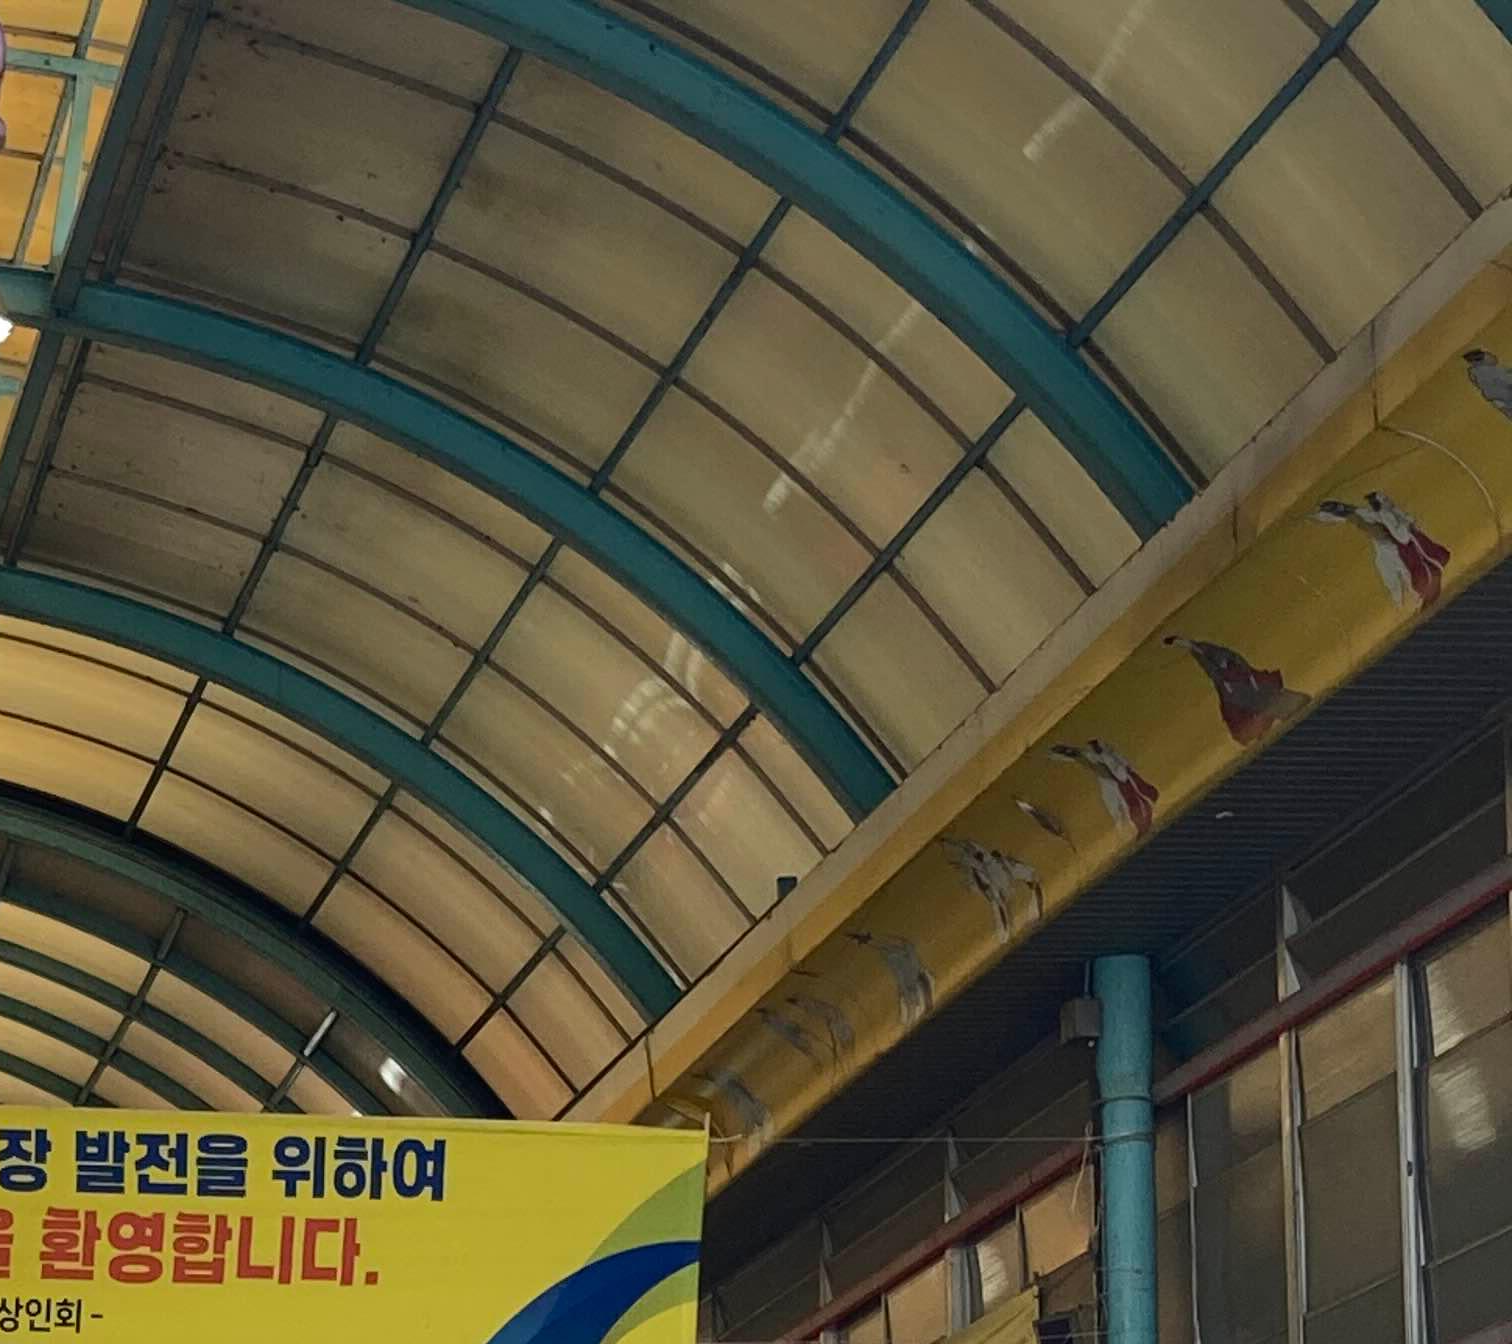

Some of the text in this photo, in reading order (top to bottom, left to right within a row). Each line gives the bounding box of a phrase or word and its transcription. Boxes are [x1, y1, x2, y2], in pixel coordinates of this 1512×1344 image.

[73, 1131, 248, 1198] 발전을
[271, 1137, 448, 1202] 위하여
[40, 1211, 380, 1288] 환영합니다.
